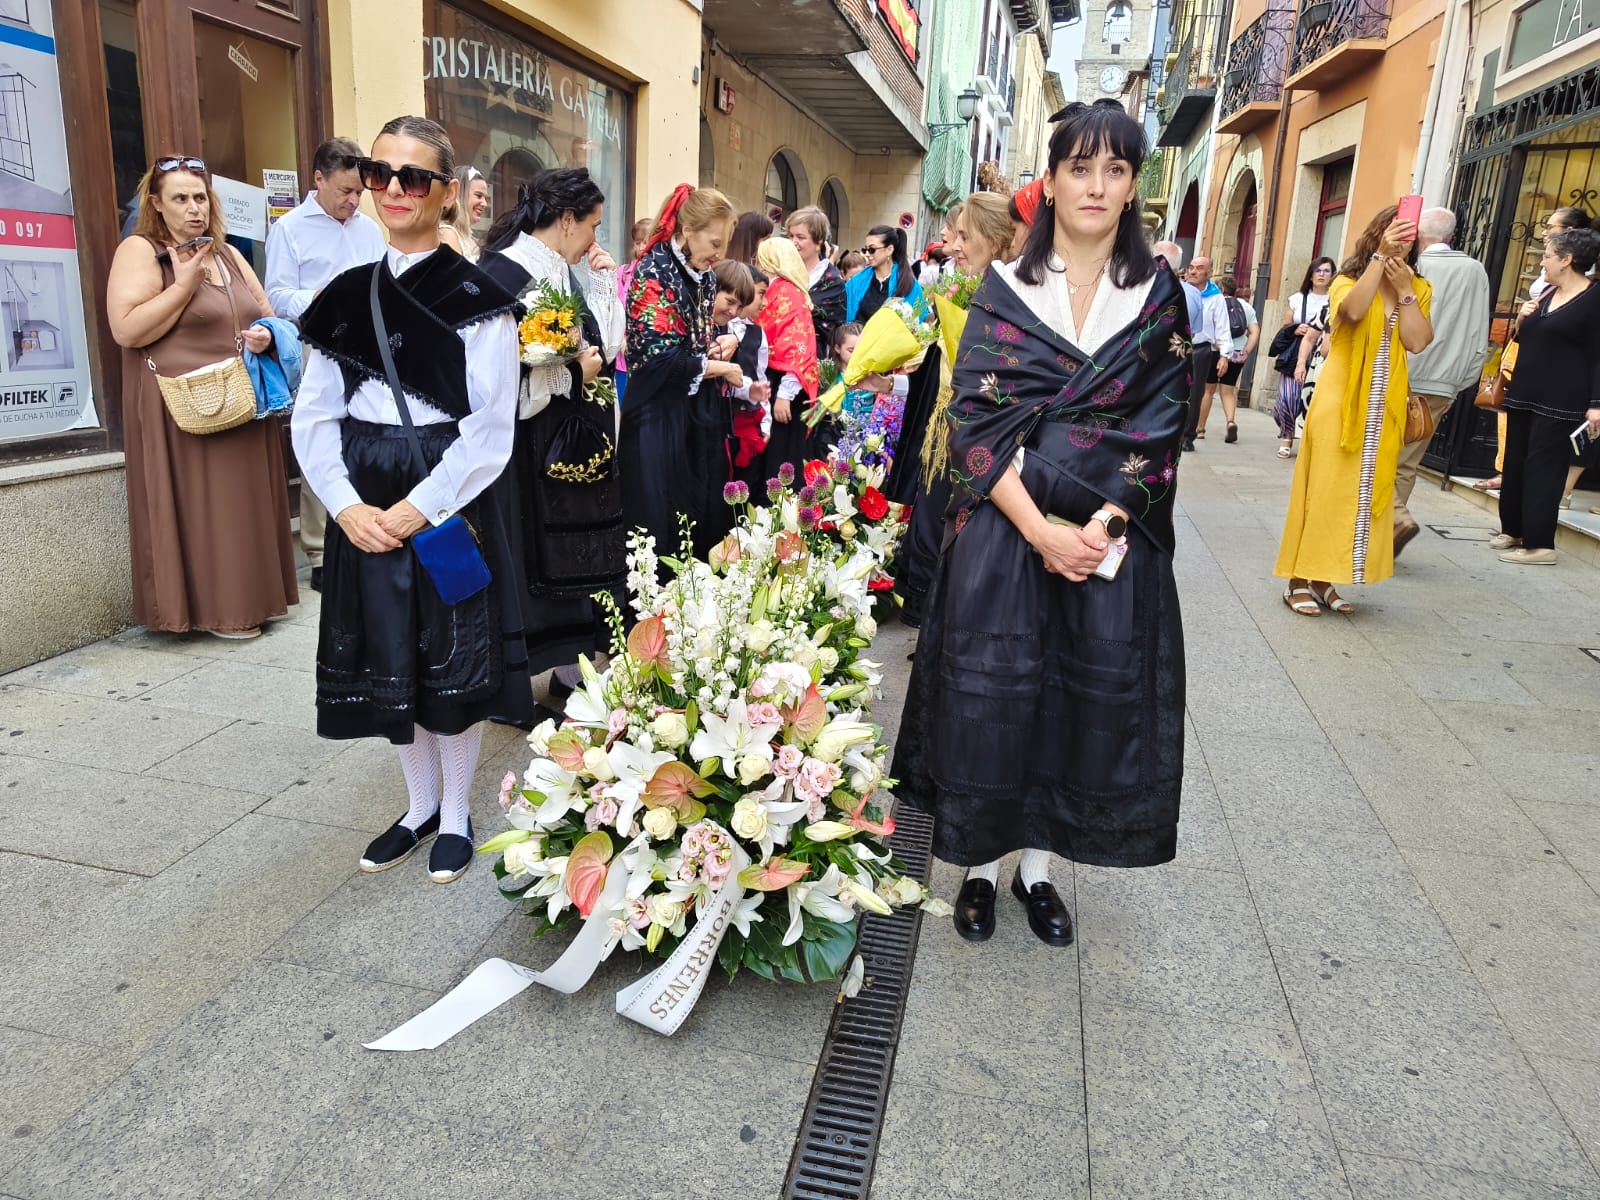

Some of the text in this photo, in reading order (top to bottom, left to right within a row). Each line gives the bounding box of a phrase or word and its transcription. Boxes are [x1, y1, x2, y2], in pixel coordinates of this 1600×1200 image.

[1552, 0, 1582, 48] LA
[230, 49, 257, 78] CERRADO
[560, 76, 622, 153] GAVELA
[15, 221, 43, 238] 097
[3, 415, 13, 423] DE
[15, 412, 38, 422] DUCHA
[46, 410, 54, 419] TU
[56, 408, 80, 418] MEDIDA
[650, 899, 732, 1021] BORRENES
